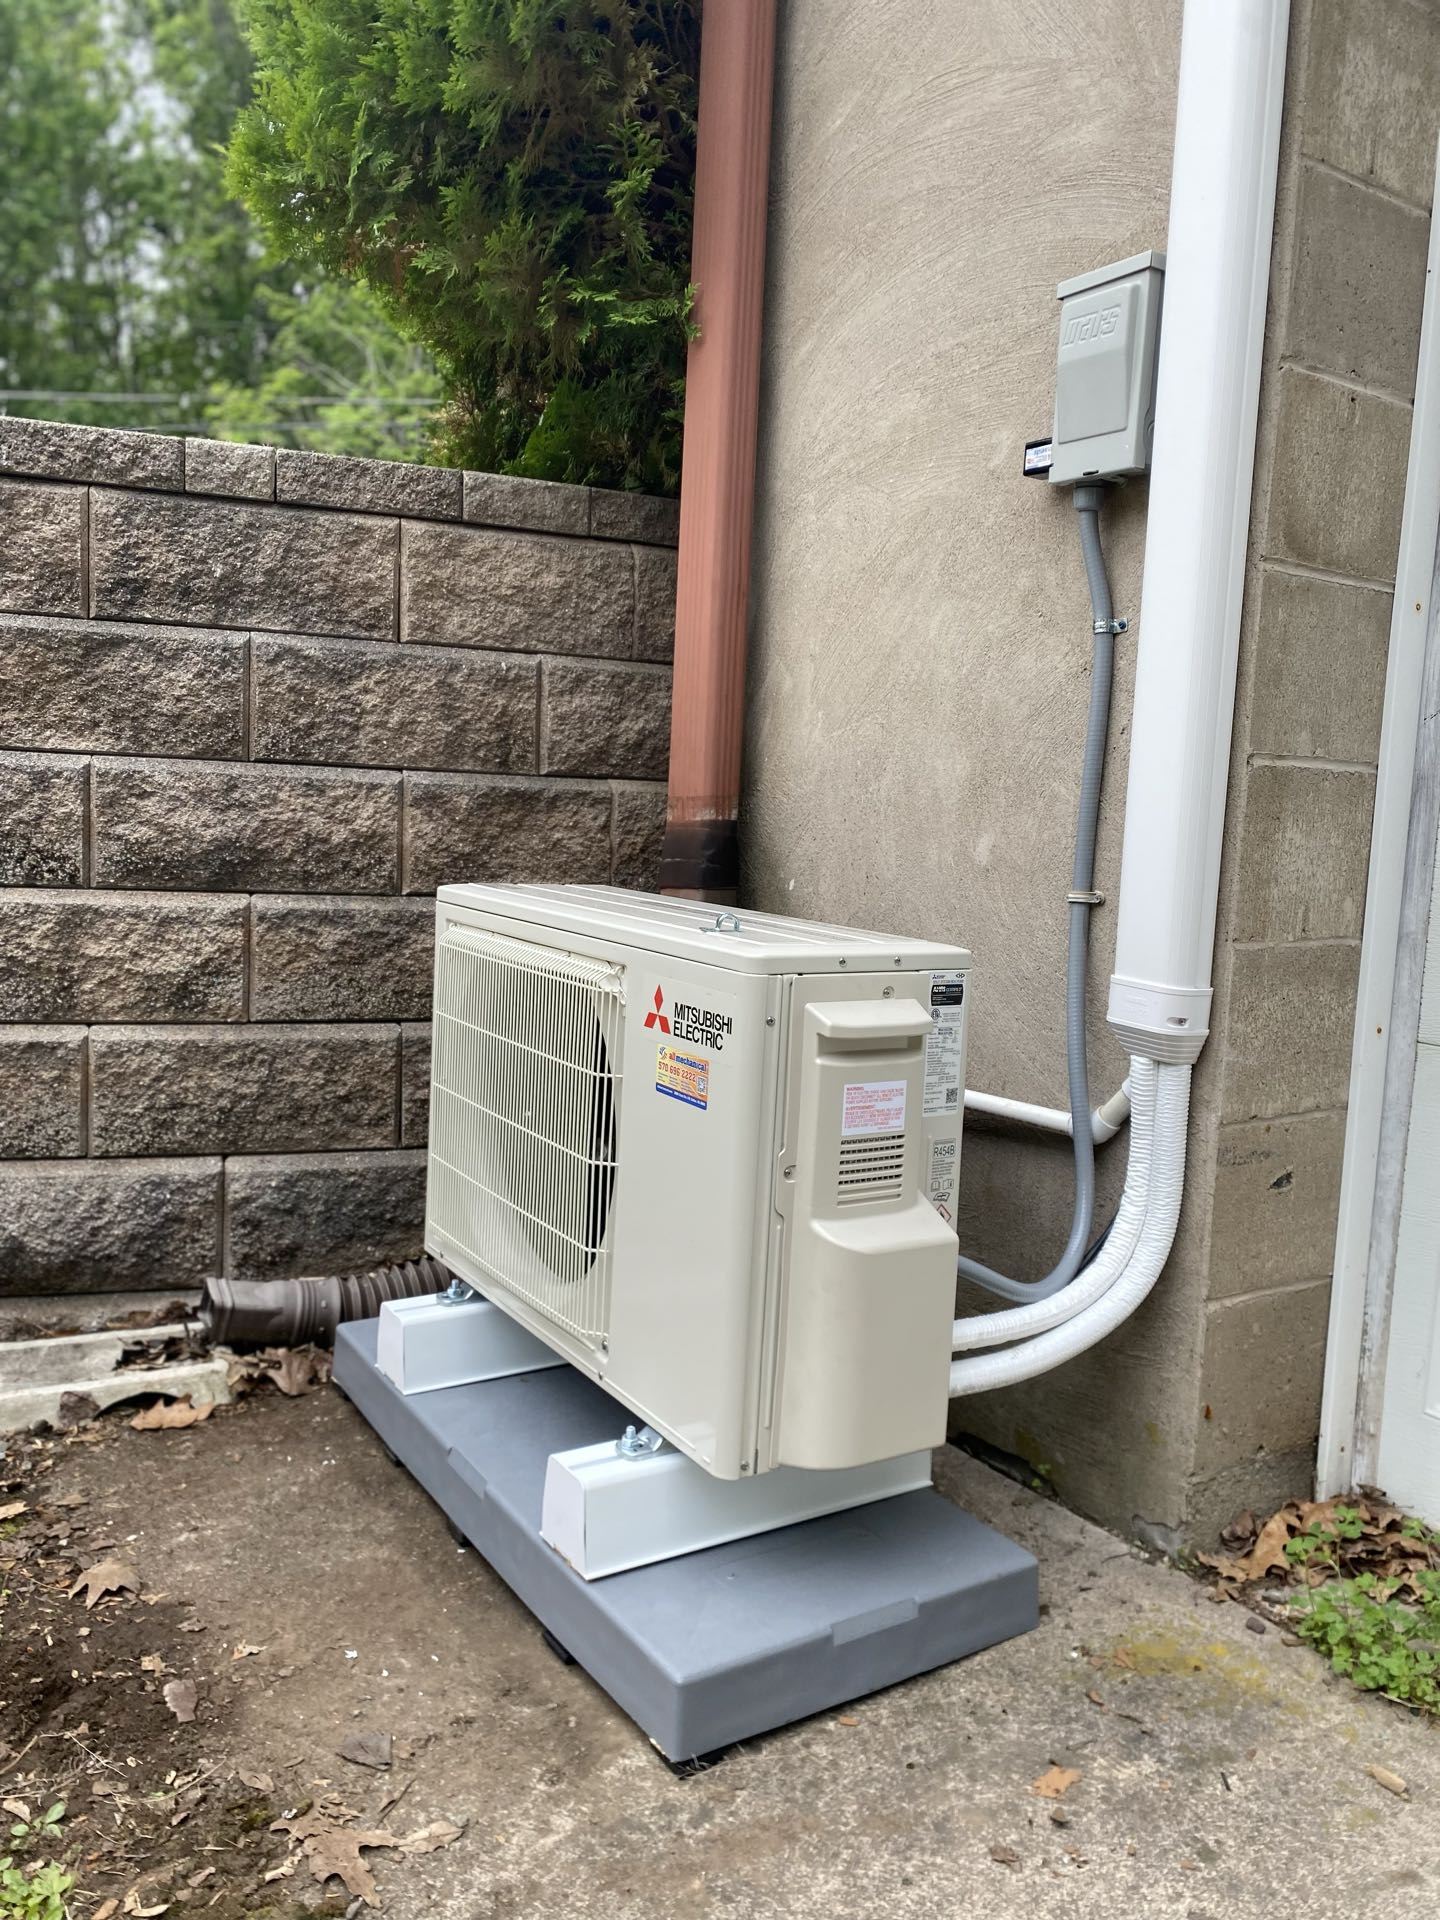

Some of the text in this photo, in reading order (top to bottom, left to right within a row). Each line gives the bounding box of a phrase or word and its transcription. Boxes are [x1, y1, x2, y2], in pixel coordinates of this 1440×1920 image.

[674, 1002, 733, 1035] MITSUBISHI
[673, 1021, 724, 1051] ELECTRIC
[658, 1061, 696, 1082] 570 696 2222
[933, 1144, 955, 1158] R454B
